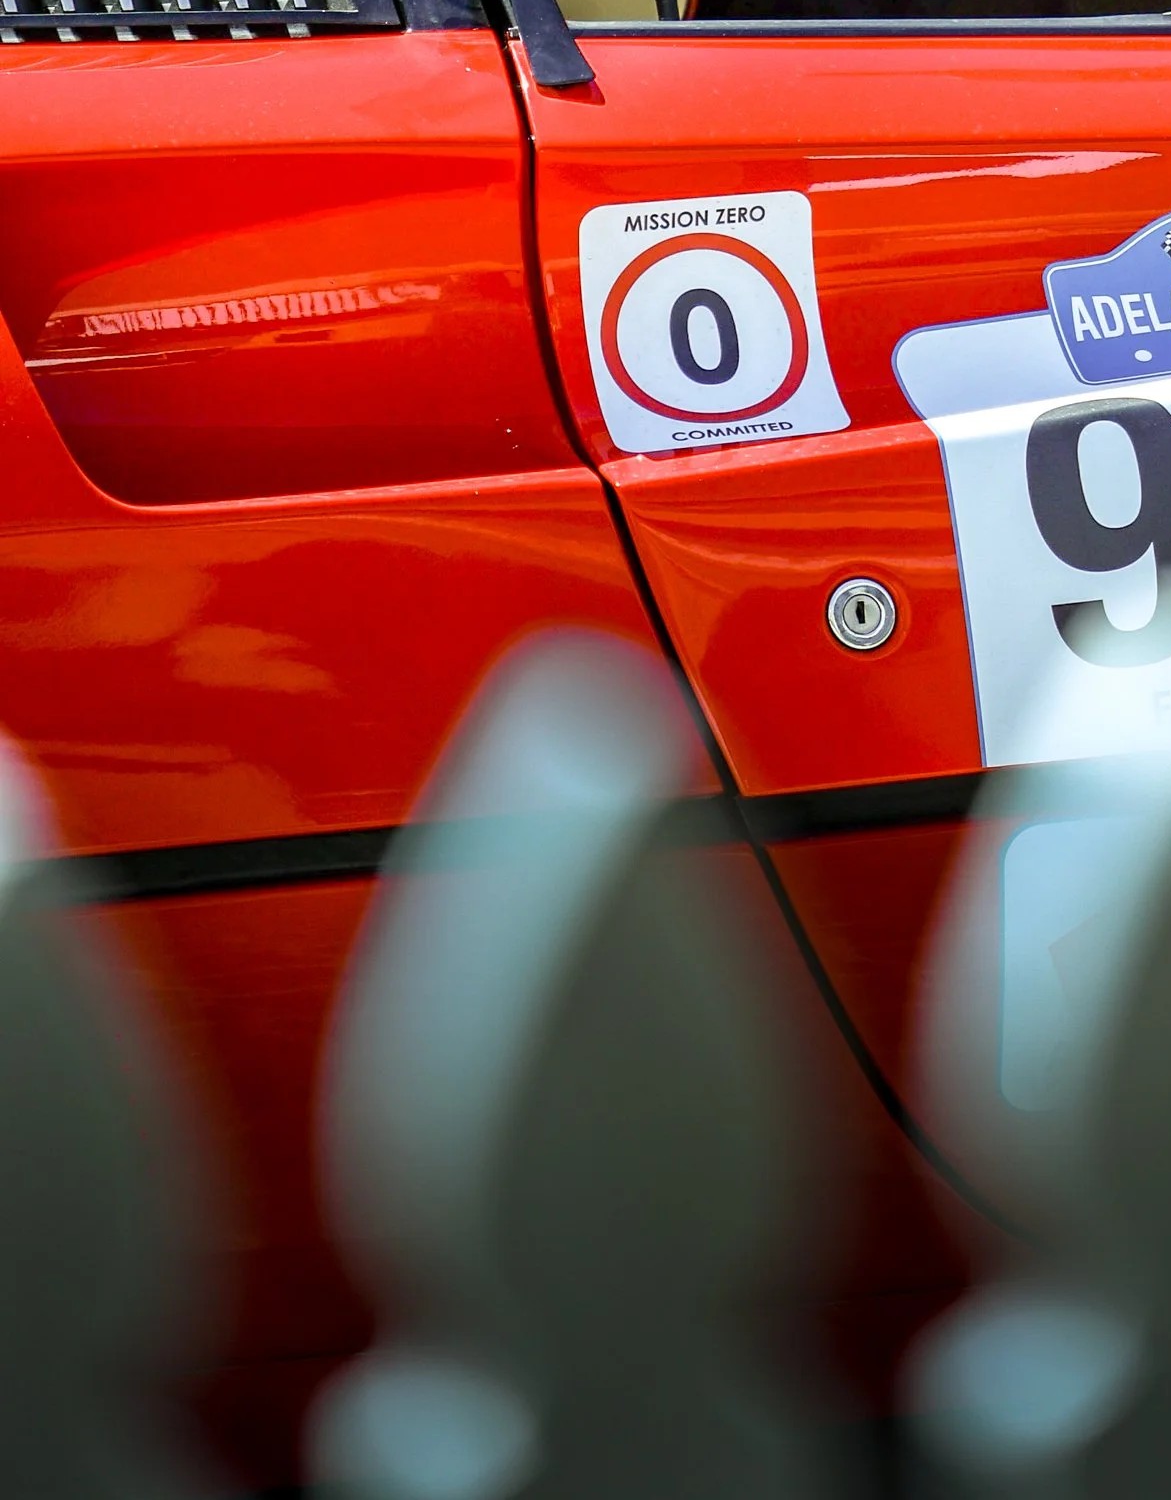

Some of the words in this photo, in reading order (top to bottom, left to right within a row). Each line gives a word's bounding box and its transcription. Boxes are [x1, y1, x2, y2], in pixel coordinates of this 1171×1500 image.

[624, 209, 708, 232] MISSION
[715, 205, 766, 225] ZERO
[669, 288, 740, 385] 0
[672, 420, 793, 442] COMMITTED
